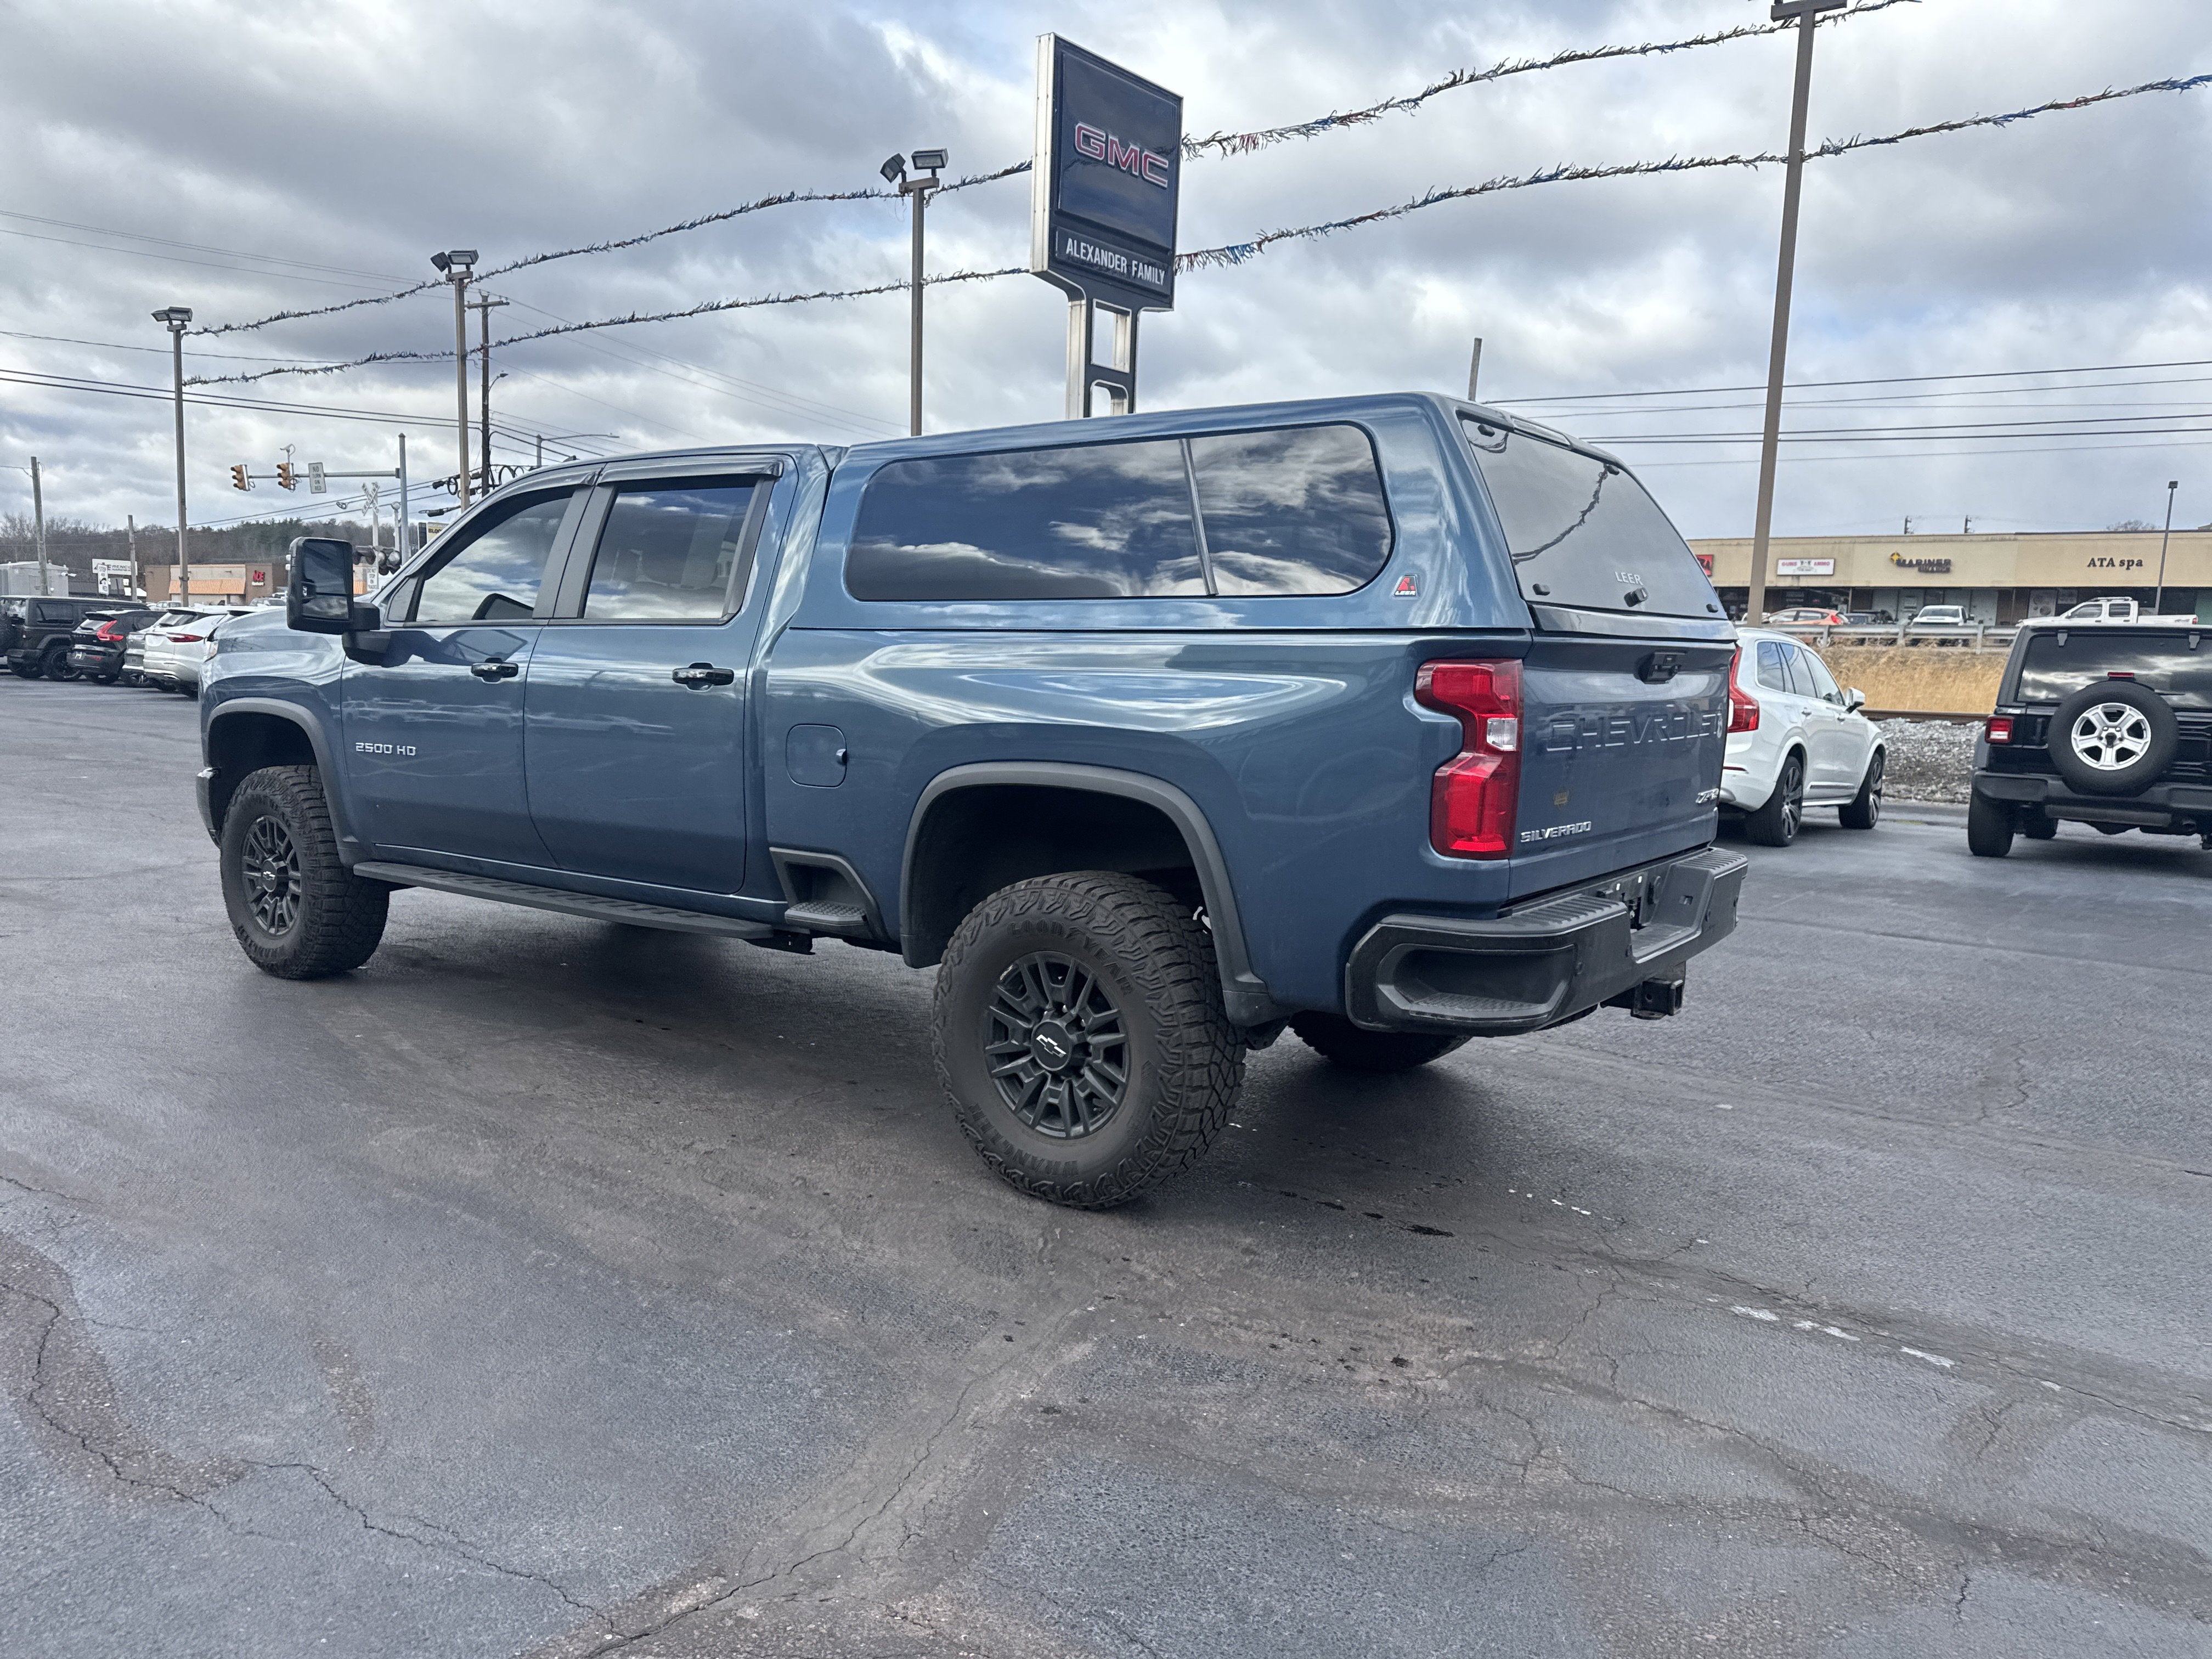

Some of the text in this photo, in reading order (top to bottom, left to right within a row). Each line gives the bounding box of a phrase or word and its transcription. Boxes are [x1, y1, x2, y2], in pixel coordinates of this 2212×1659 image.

[1075, 122, 1169, 188] GMC
[1065, 238, 1165, 285] ALEXANDER FAMILY
[1895, 558, 1951, 567] MARINER
[2087, 557, 2143, 571] ATA spa
[1615, 571, 1644, 586] LEER
[1547, 710, 1722, 752] CHEVROLET
[356, 742, 417, 757] 2500 HD
[1521, 821, 1592, 843] SILVERADO
